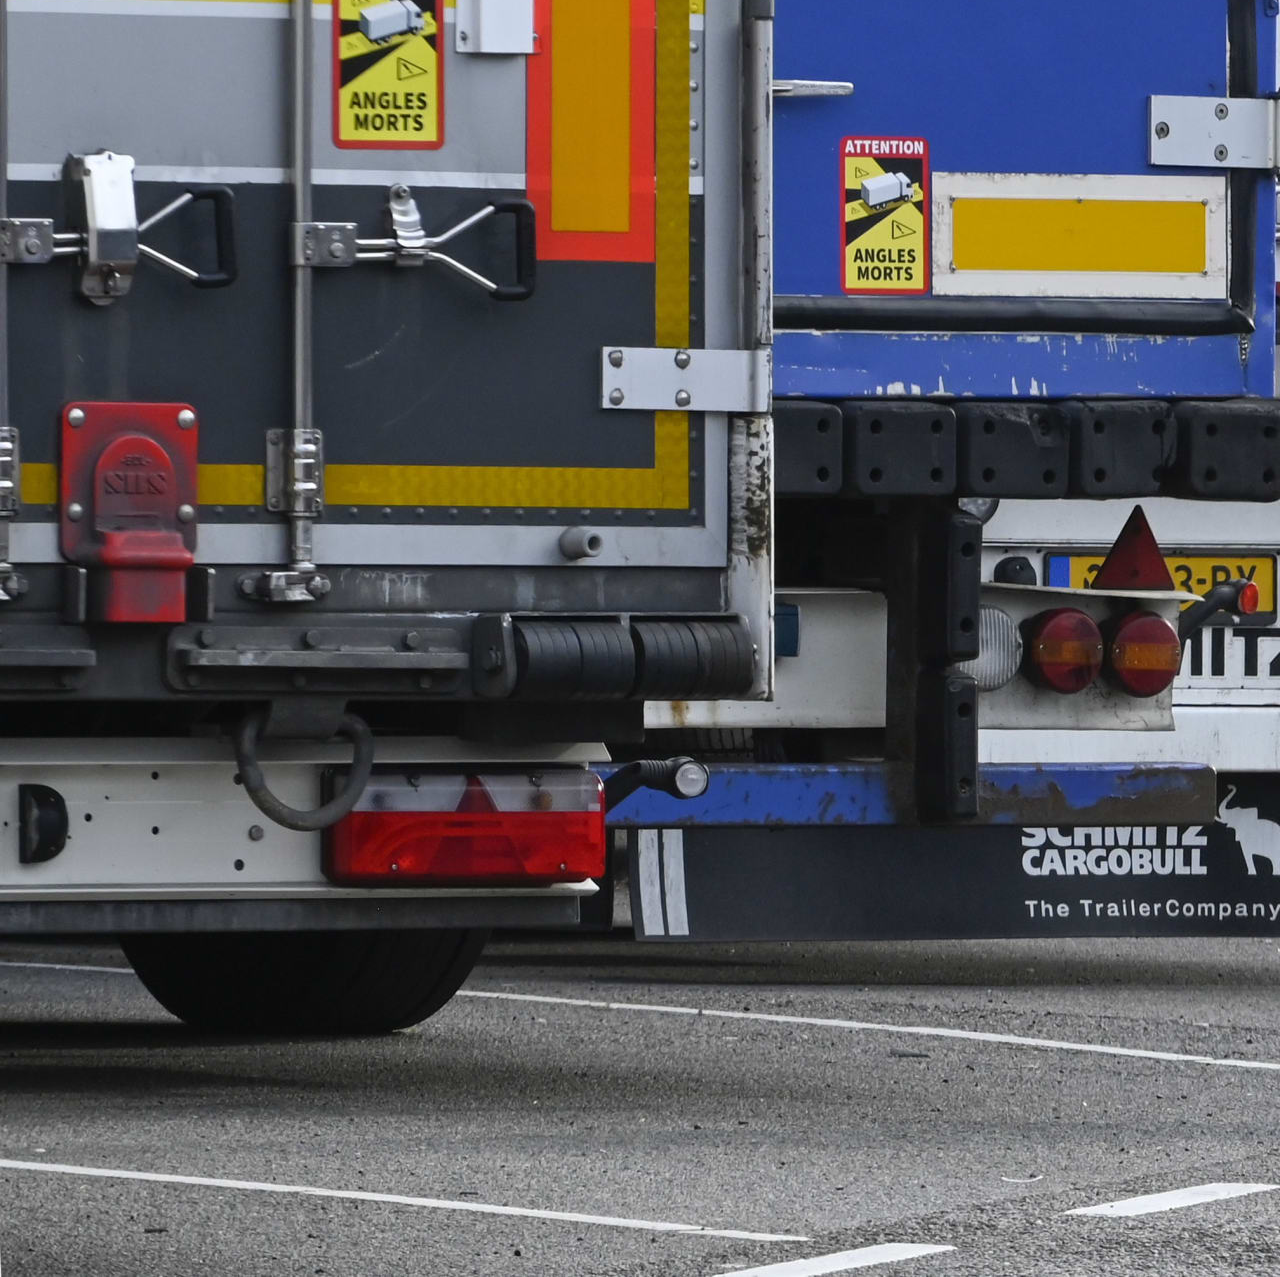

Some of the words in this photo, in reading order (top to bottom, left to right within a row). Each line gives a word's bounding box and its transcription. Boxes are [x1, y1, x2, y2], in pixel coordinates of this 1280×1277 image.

[349, 92, 428, 110] ANGLES
[354, 113, 424, 132] MORTS
[845, 140, 924, 155] ATTENTION
[853, 248, 916, 263] ANGLES
[857, 266, 913, 281] MORTS
[1021, 848, 1208, 876] CARGOBULL
[1025, 900, 1070, 918] The
